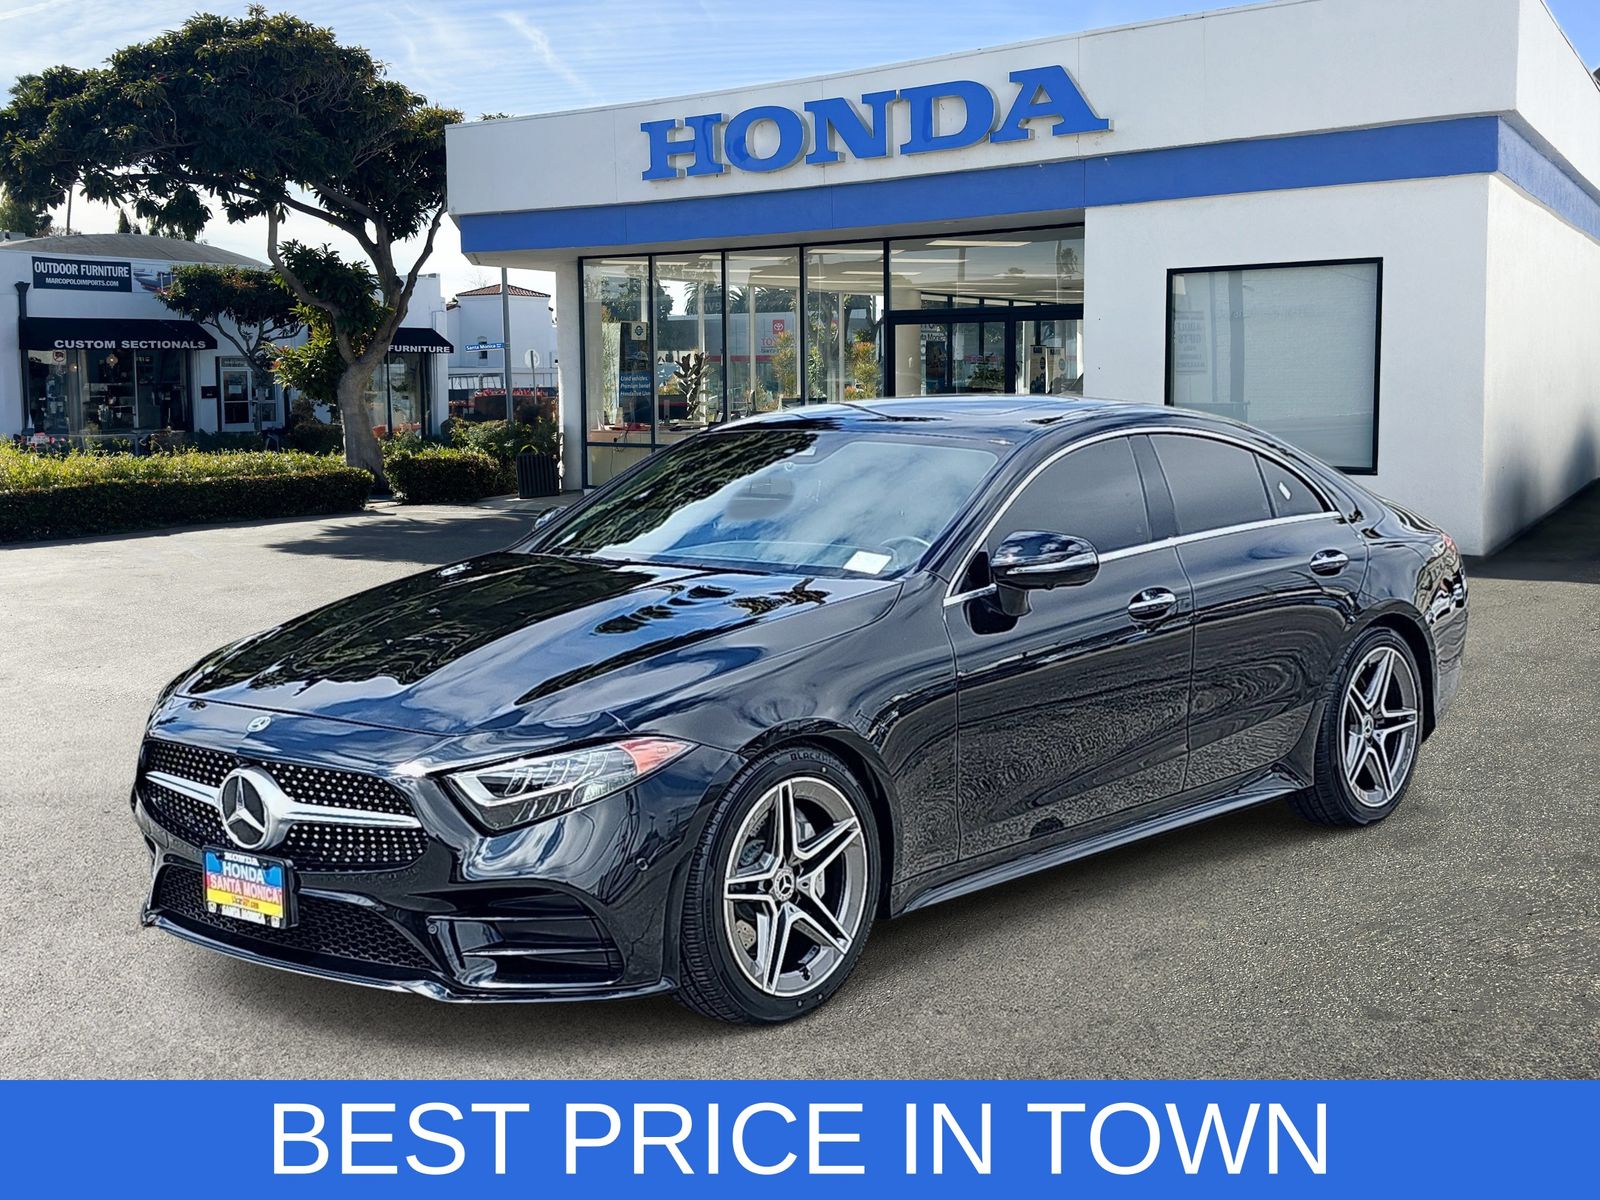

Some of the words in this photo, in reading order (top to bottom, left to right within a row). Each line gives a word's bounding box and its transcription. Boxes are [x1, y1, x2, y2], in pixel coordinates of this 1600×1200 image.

[640, 64, 1112, 182] HONDA
[34, 261, 78, 276] OUTDOOR
[80, 264, 130, 278] FURNITURE
[45, 277, 119, 287] MARCOPOLOIMPORTS.COM
[54, 339, 116, 349] CUSTOM
[121, 340, 206, 349] SECTIONALS
[388, 344, 450, 353] FURNITURE
[222, 861, 266, 884] HONDA
[211, 874, 242, 896] SANTA
[242, 881, 280, 905] MONICA
